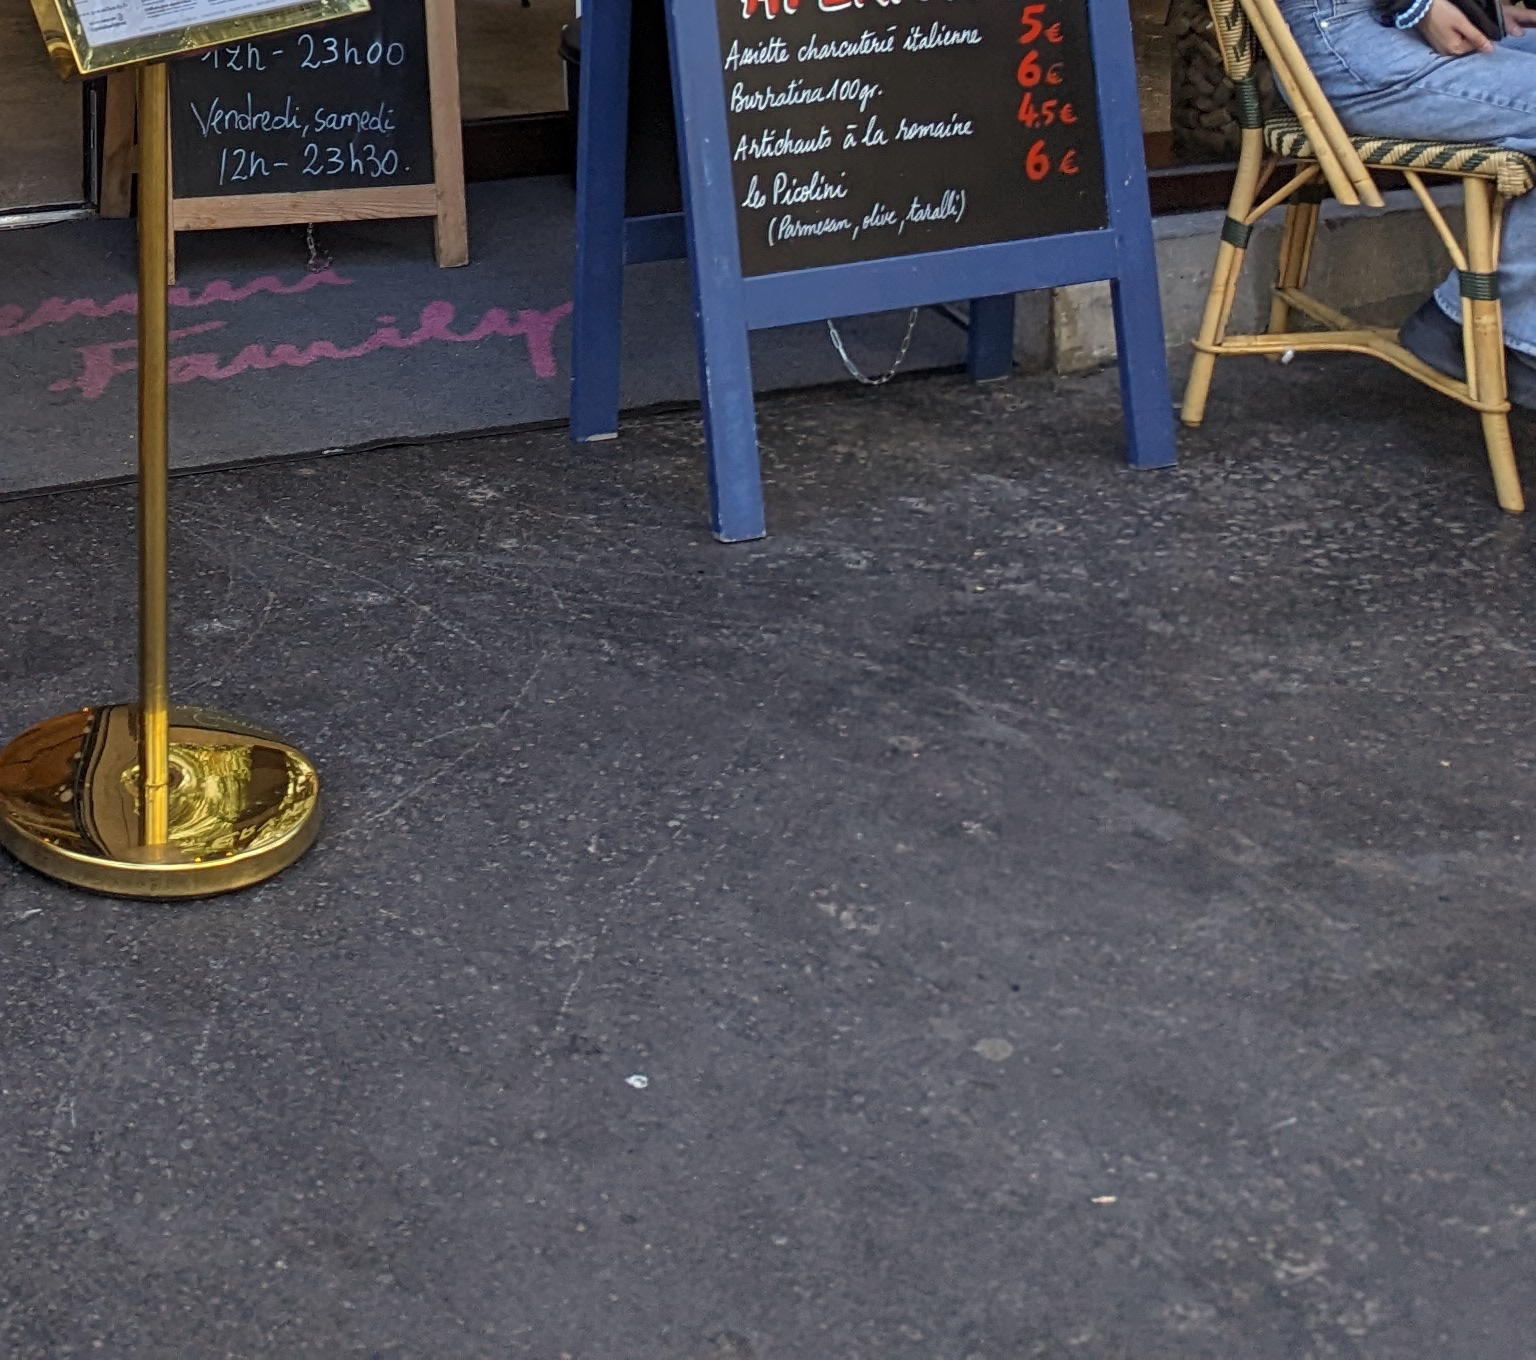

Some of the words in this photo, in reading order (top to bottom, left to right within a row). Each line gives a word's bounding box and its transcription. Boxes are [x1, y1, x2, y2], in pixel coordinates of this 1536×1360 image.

[297, 33, 406, 71] 23h00
[724, 34, 790, 71] Assiette
[902, 20, 983, 53] italienne
[190, 91, 309, 139] Vendredi,
[314, 101, 396, 134] samedi
[733, 127, 832, 162] Artichauts
[861, 114, 888, 148] la
[895, 112, 974, 142] romaine
[218, 147, 271, 186] 12h
[772, 171, 849, 207] Picolini
[48, 300, 574, 400] Family
